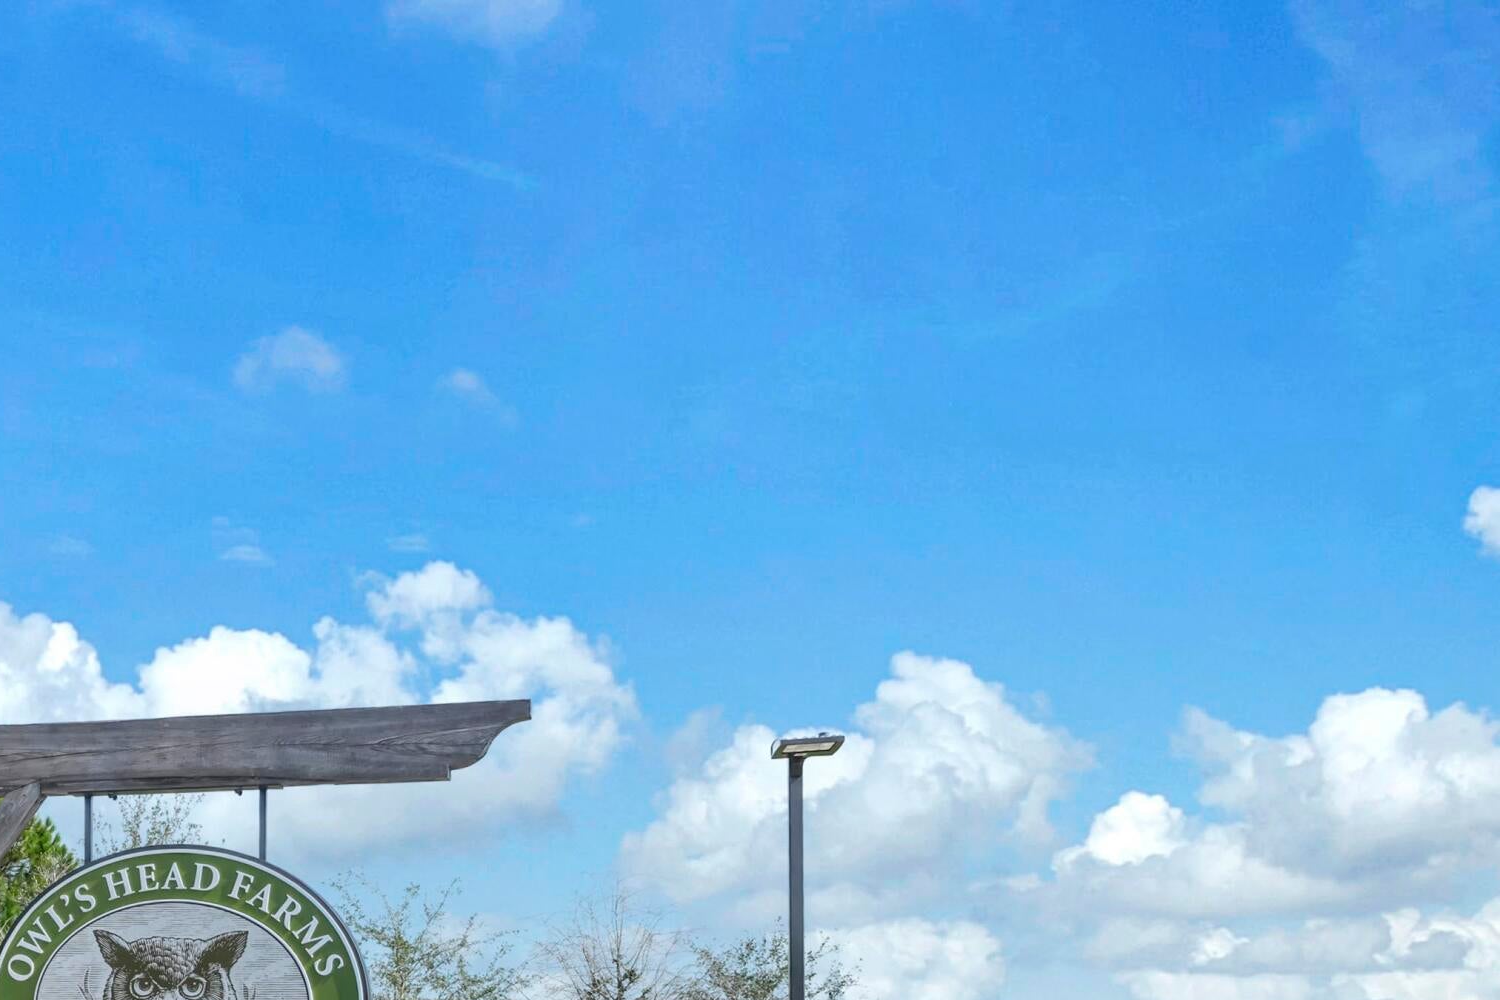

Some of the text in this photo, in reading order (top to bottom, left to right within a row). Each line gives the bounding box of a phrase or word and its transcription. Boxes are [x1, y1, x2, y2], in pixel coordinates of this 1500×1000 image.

[7, 861, 345, 982] OWL'S HEAD FARMS
